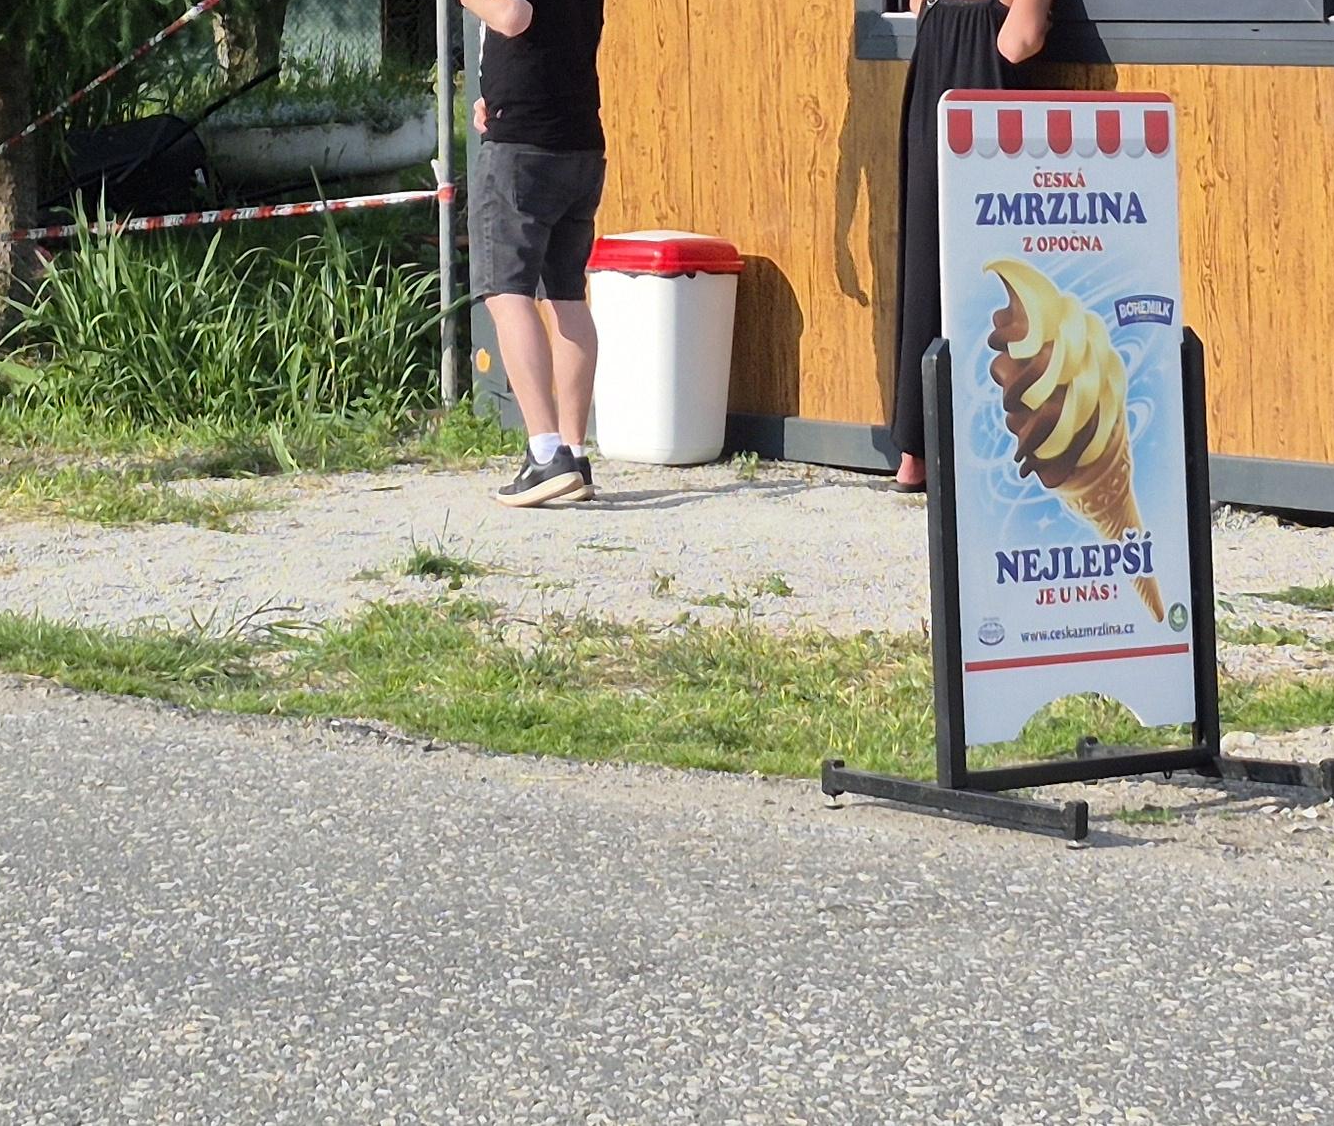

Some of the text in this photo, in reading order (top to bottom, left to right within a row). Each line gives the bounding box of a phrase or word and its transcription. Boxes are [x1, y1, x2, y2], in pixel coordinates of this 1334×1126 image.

[1033, 166, 1086, 188] ČESKÁ
[974, 191, 1148, 226] ZMRZLINA
[1022, 229, 1104, 253] Z OPOČNA
[995, 530, 1155, 585] NEJLEPŠÍ
[1035, 588, 1056, 606] JE
[1059, 587, 1072, 604] U
[1020, 622, 1135, 643] www.ceskazmrzlina.cz
